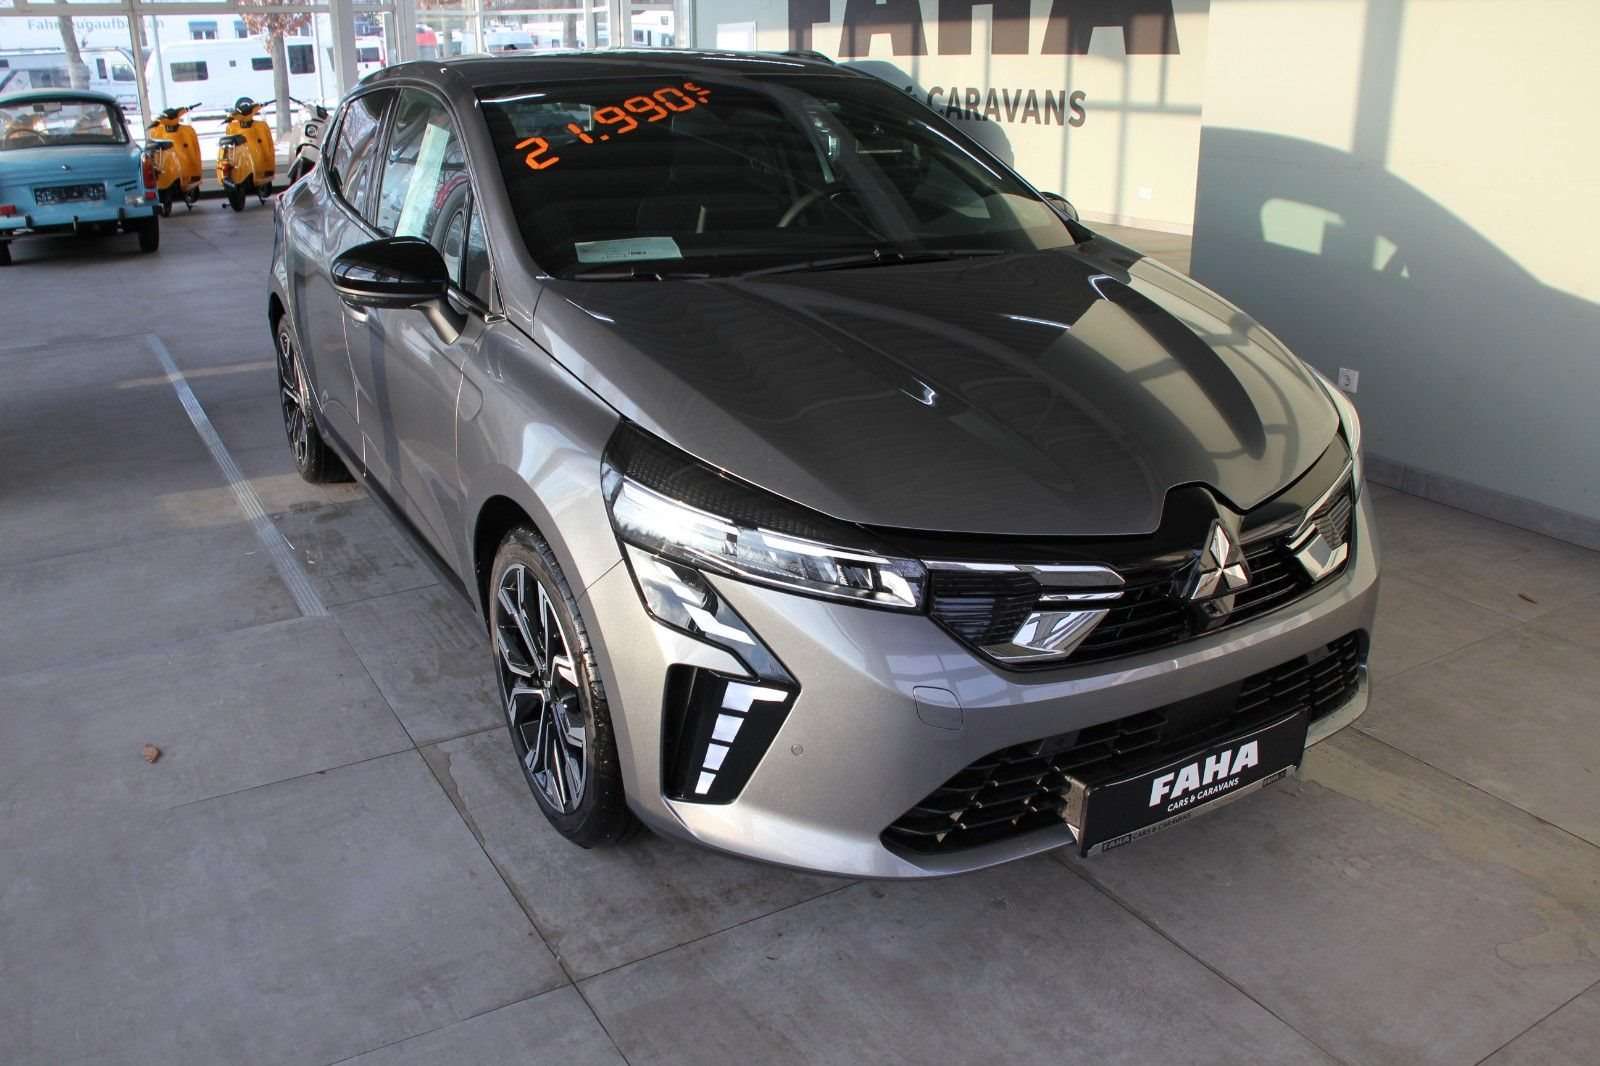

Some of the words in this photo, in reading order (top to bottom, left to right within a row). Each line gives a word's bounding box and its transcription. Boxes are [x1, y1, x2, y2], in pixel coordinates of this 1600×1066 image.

[927, 86, 1087, 128] CARAVANS
[1149, 740, 1258, 807] FAHA
[1167, 797, 1189, 812] CARS
[1189, 795, 1196, 803] &
[1197, 777, 1240, 800] CARAVANS
